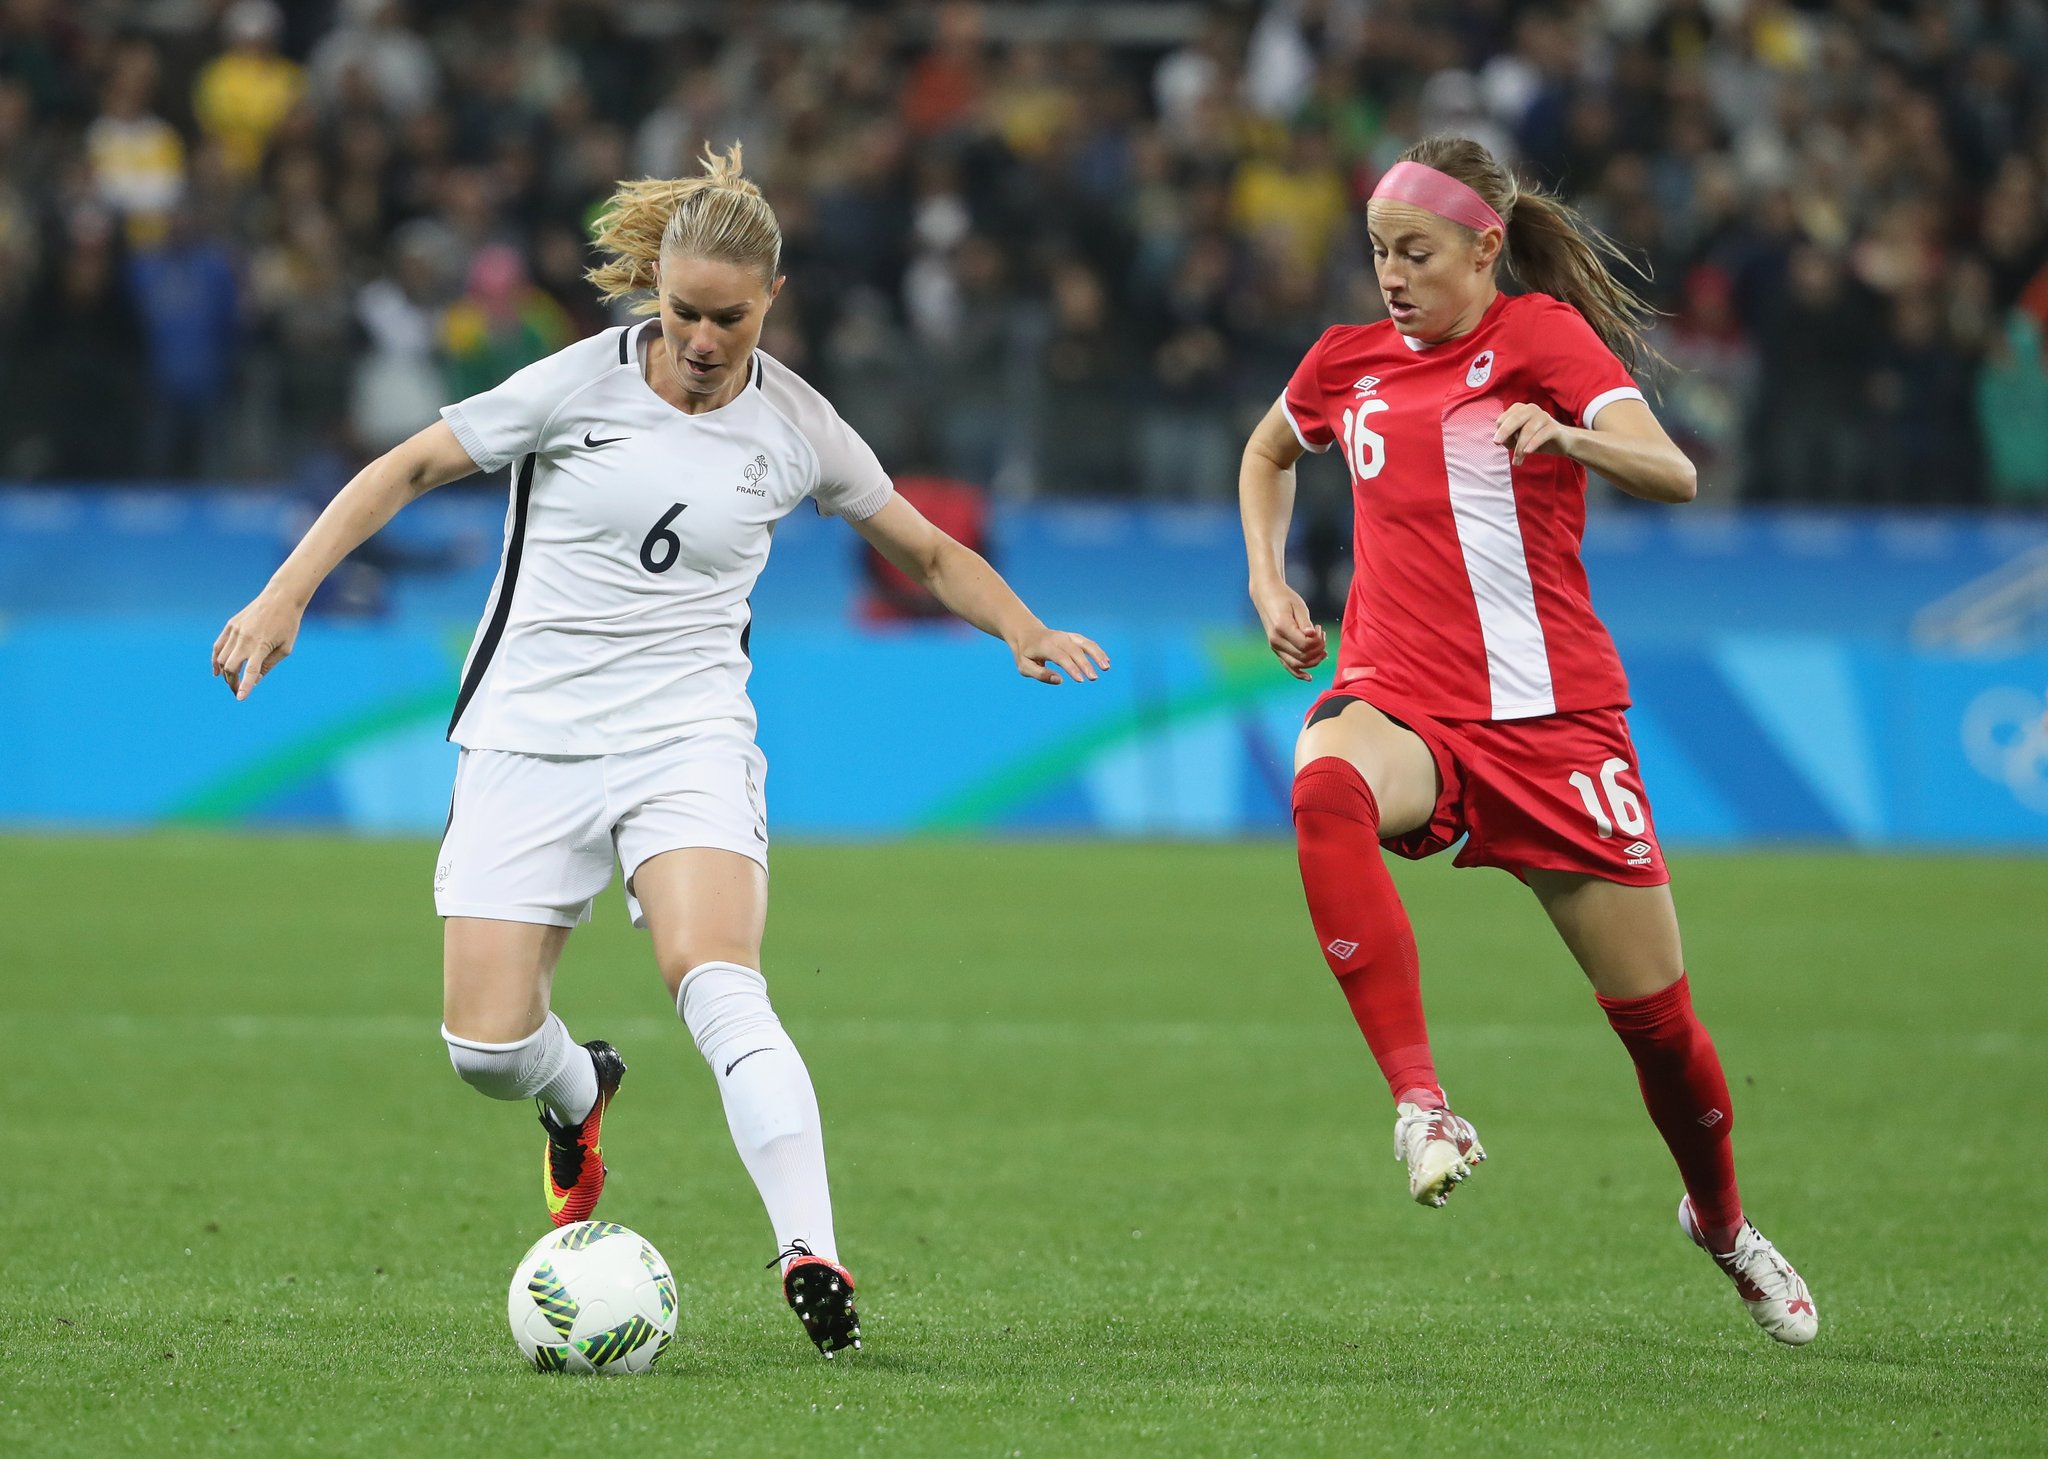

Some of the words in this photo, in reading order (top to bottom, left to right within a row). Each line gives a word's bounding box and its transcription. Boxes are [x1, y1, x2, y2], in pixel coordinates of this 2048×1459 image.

[1343, 399, 1389, 486] 16
[736, 485, 767, 498] FRANCE
[639, 502, 688, 574] 6
[1568, 757, 1645, 839] 16
[1627, 856, 1652, 865] umbro
